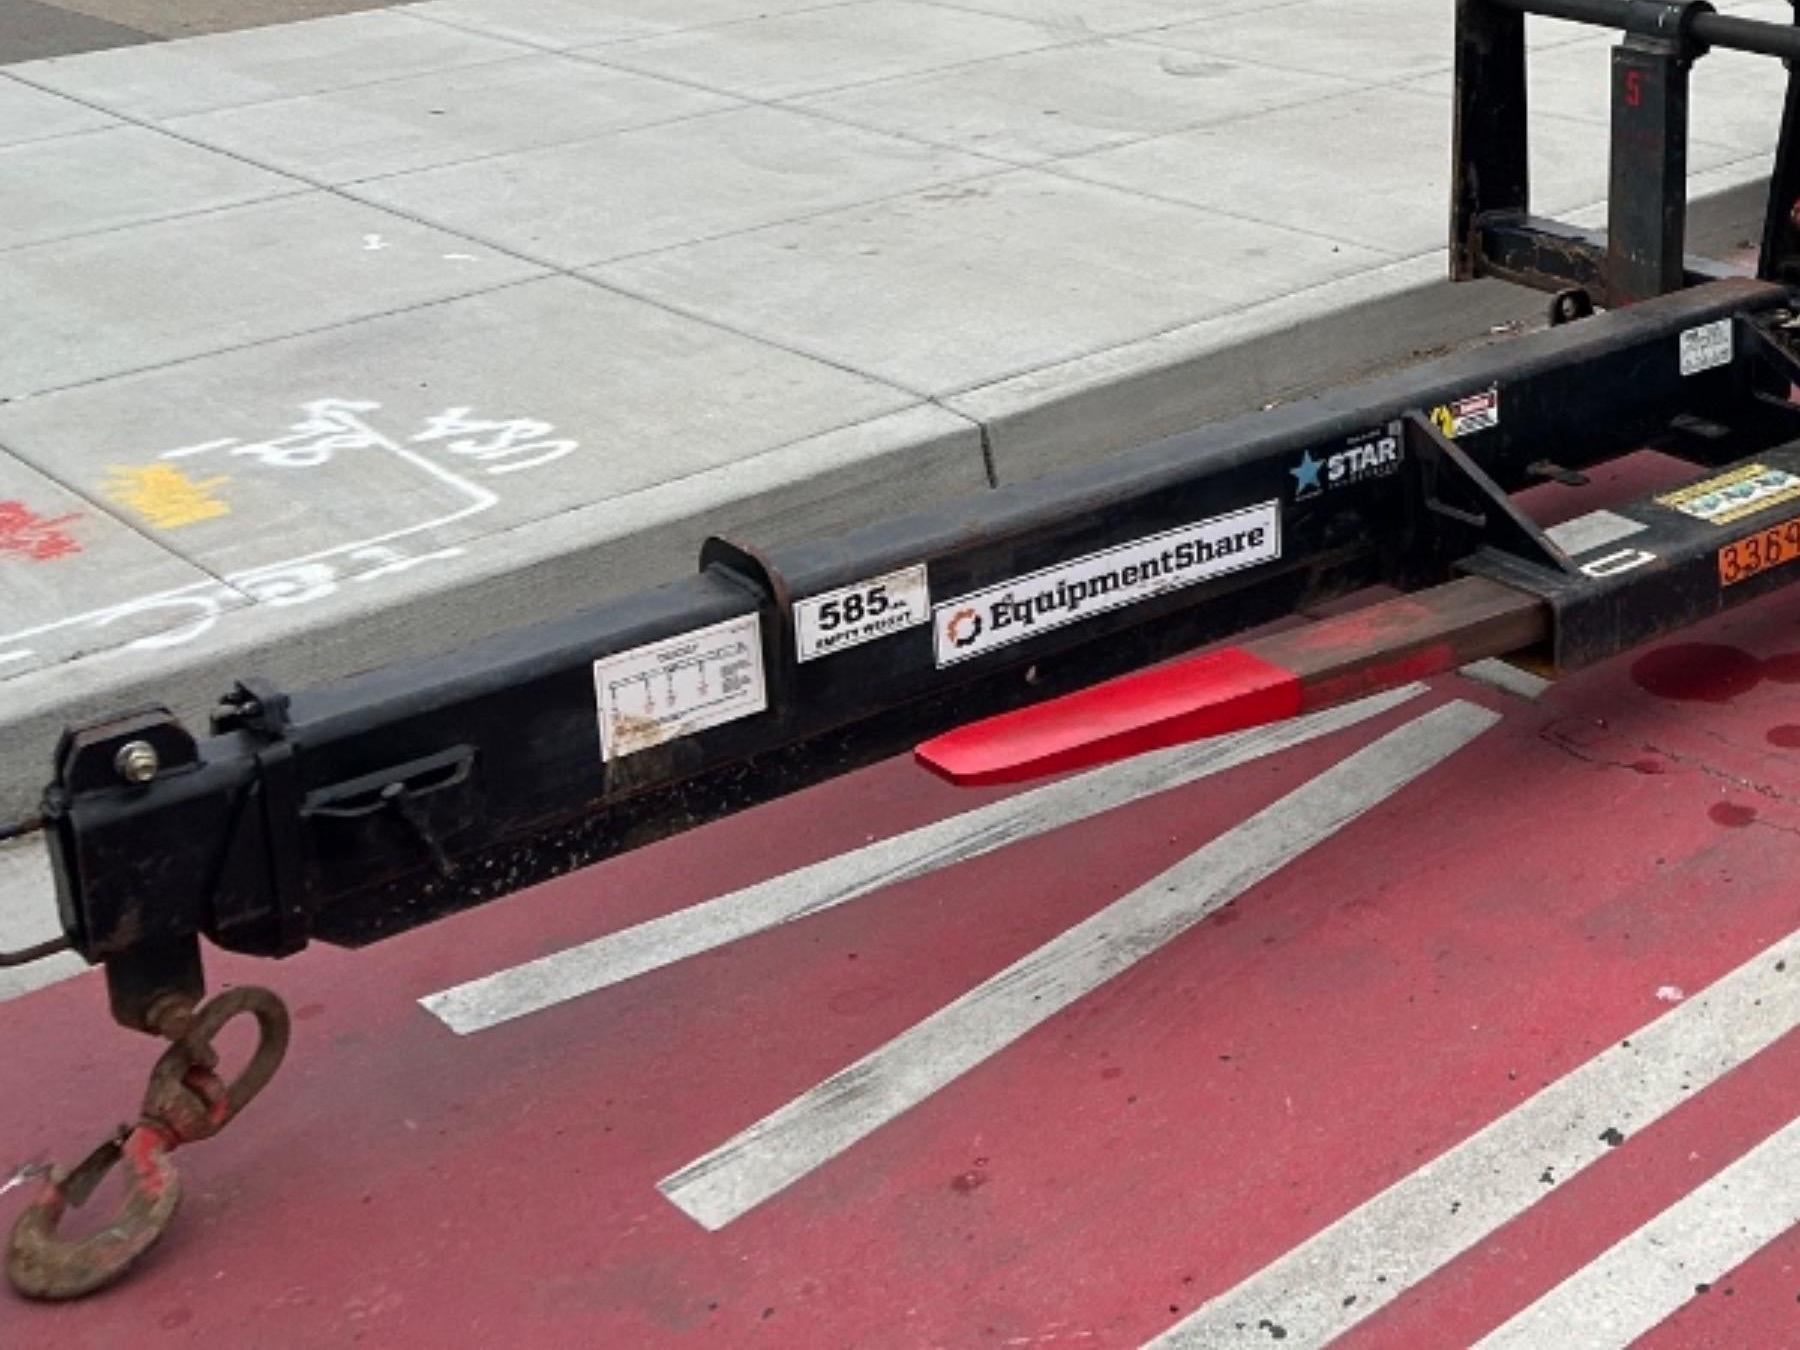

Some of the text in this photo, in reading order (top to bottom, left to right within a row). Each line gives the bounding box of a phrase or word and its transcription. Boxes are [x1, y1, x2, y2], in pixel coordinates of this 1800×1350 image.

[1328, 437, 1396, 481] STAR
[988, 526, 1266, 631] EquipmentShare
[818, 585, 889, 631] 585
